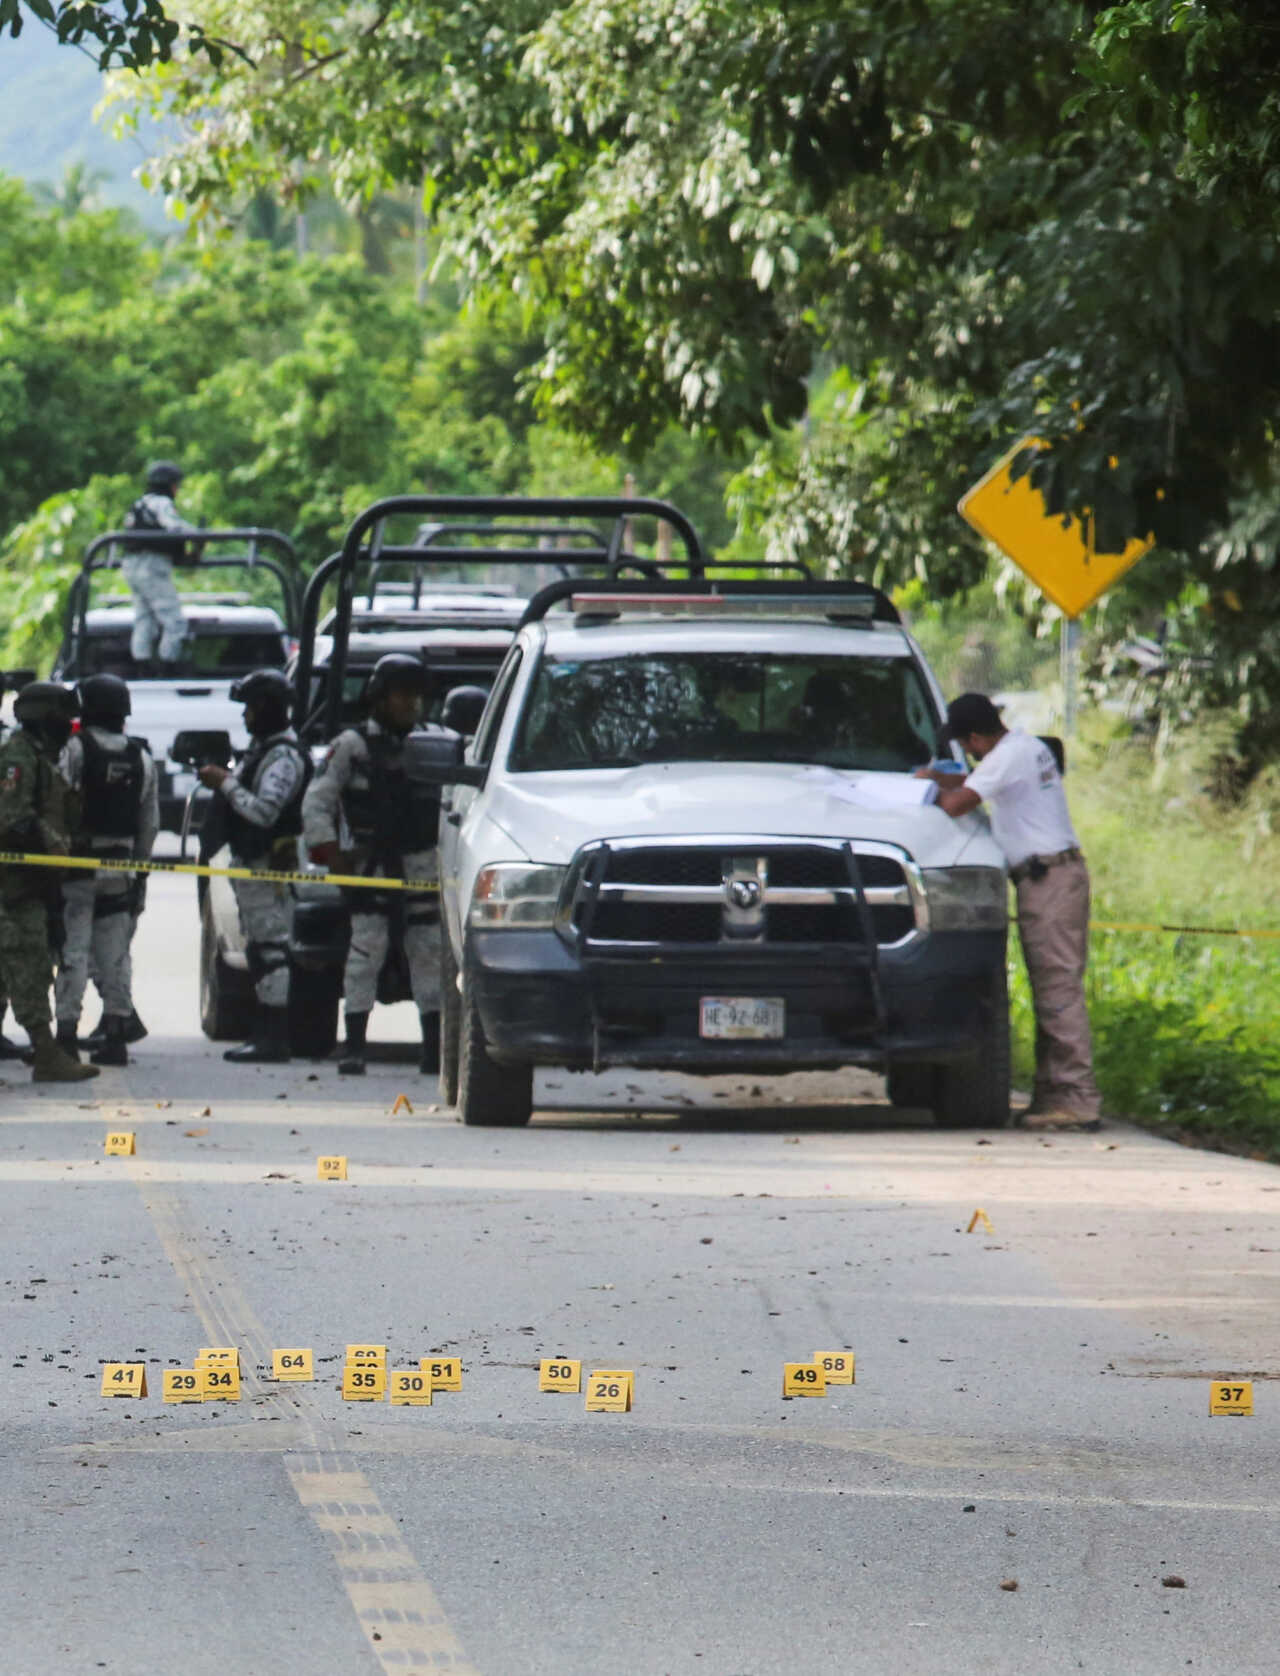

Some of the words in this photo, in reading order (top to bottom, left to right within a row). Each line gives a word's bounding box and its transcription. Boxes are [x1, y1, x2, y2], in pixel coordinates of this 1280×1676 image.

[111, 1136, 127, 1146] 93
[323, 1160, 340, 1170] 92
[281, 1355, 304, 1368] 64
[823, 1358, 845, 1371] 68
[112, 1370, 135, 1383] 41
[431, 1364, 453, 1377] 51
[548, 1365, 572, 1379] 50
[793, 1369, 817, 1383] 49
[172, 1375, 196, 1389] 29
[208, 1372, 233, 1386] 34
[351, 1373, 376, 1387] 35
[399, 1377, 423, 1391] 30
[595, 1384, 620, 1397] 26
[1220, 1387, 1244, 1401] 37
